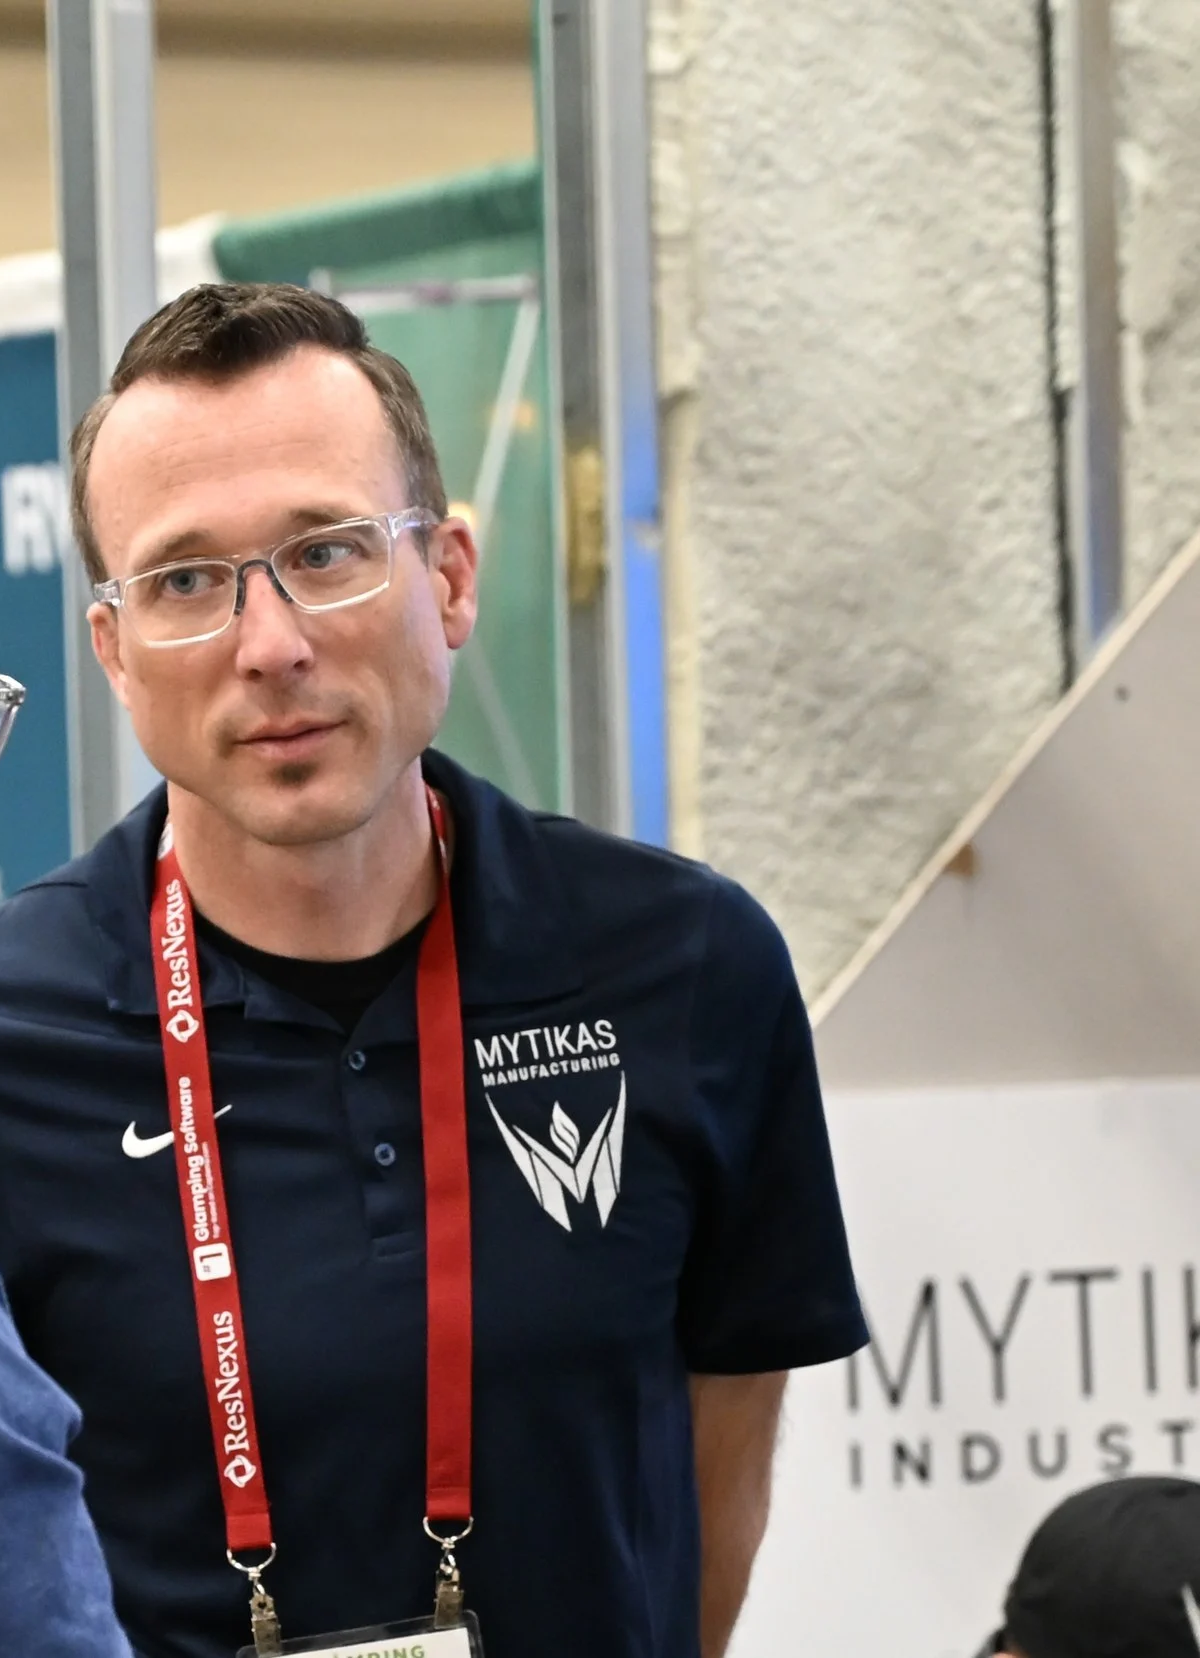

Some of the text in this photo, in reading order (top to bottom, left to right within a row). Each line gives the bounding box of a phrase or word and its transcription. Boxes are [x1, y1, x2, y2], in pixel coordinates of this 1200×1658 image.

[161, 878, 194, 1010] ResNexus
[474, 1019, 617, 1069] MYTIKAS
[482, 1052, 621, 1087] MANUFACTURING
[177, 1076, 199, 1154] Software
[187, 1155, 210, 1242] Glamping
[213, 1310, 250, 1455] ResNexus
[850, 1415, 1196, 1488] INDUST
